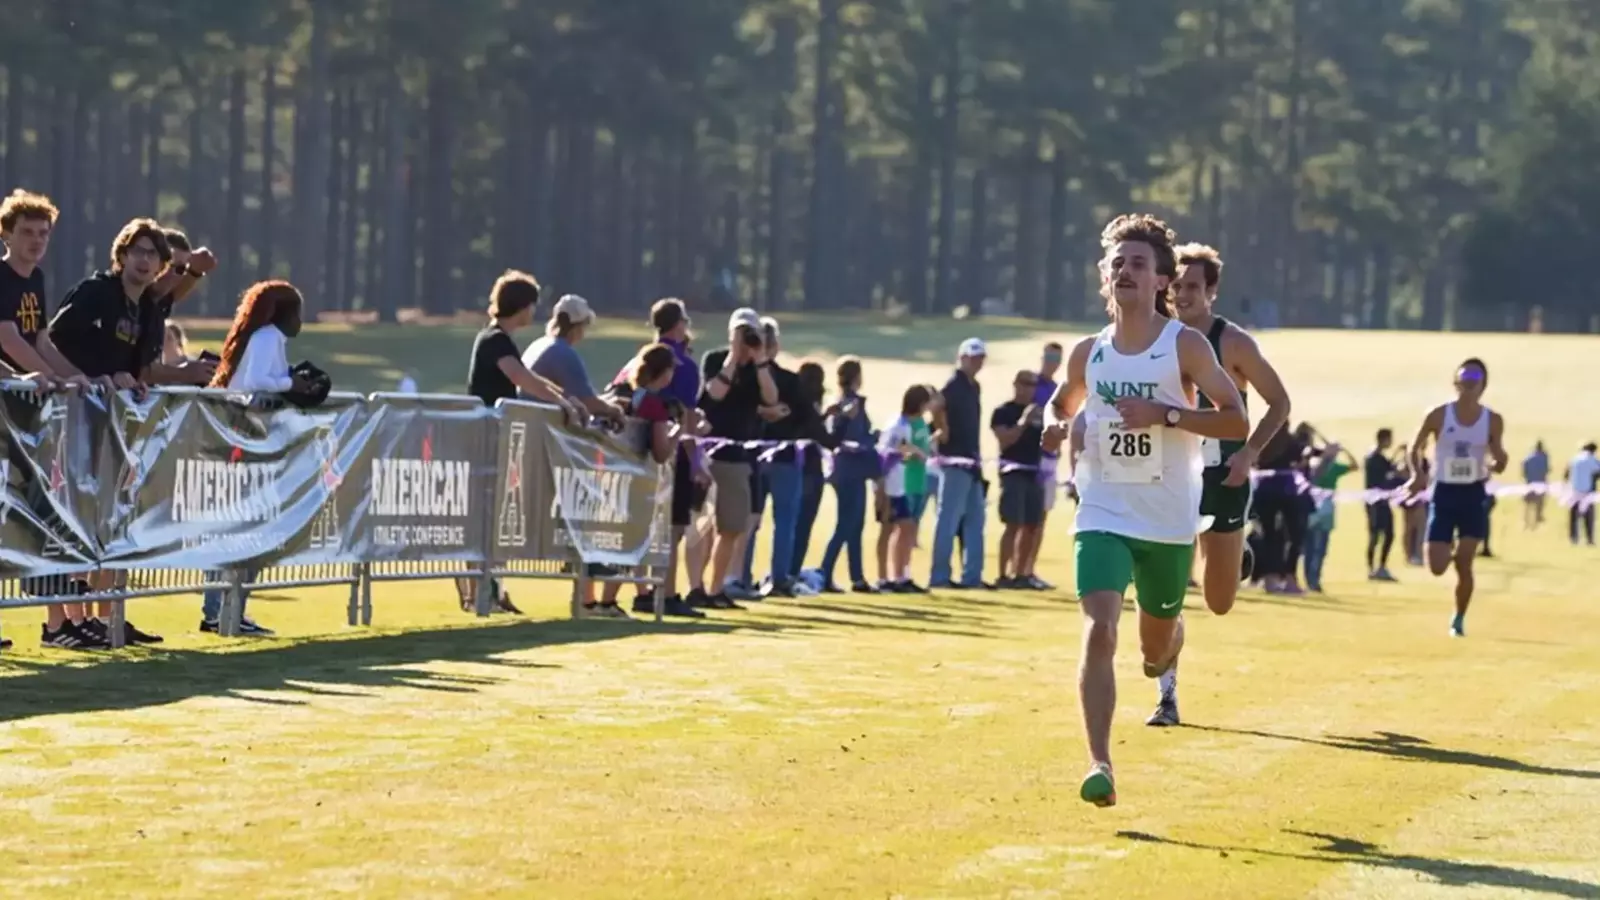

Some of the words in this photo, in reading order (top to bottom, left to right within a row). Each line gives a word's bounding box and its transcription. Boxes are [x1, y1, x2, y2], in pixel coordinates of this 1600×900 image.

[1111, 381, 1159, 400] UNT
[1109, 432, 1151, 457] 286
[368, 458, 470, 516] AMERICAN
